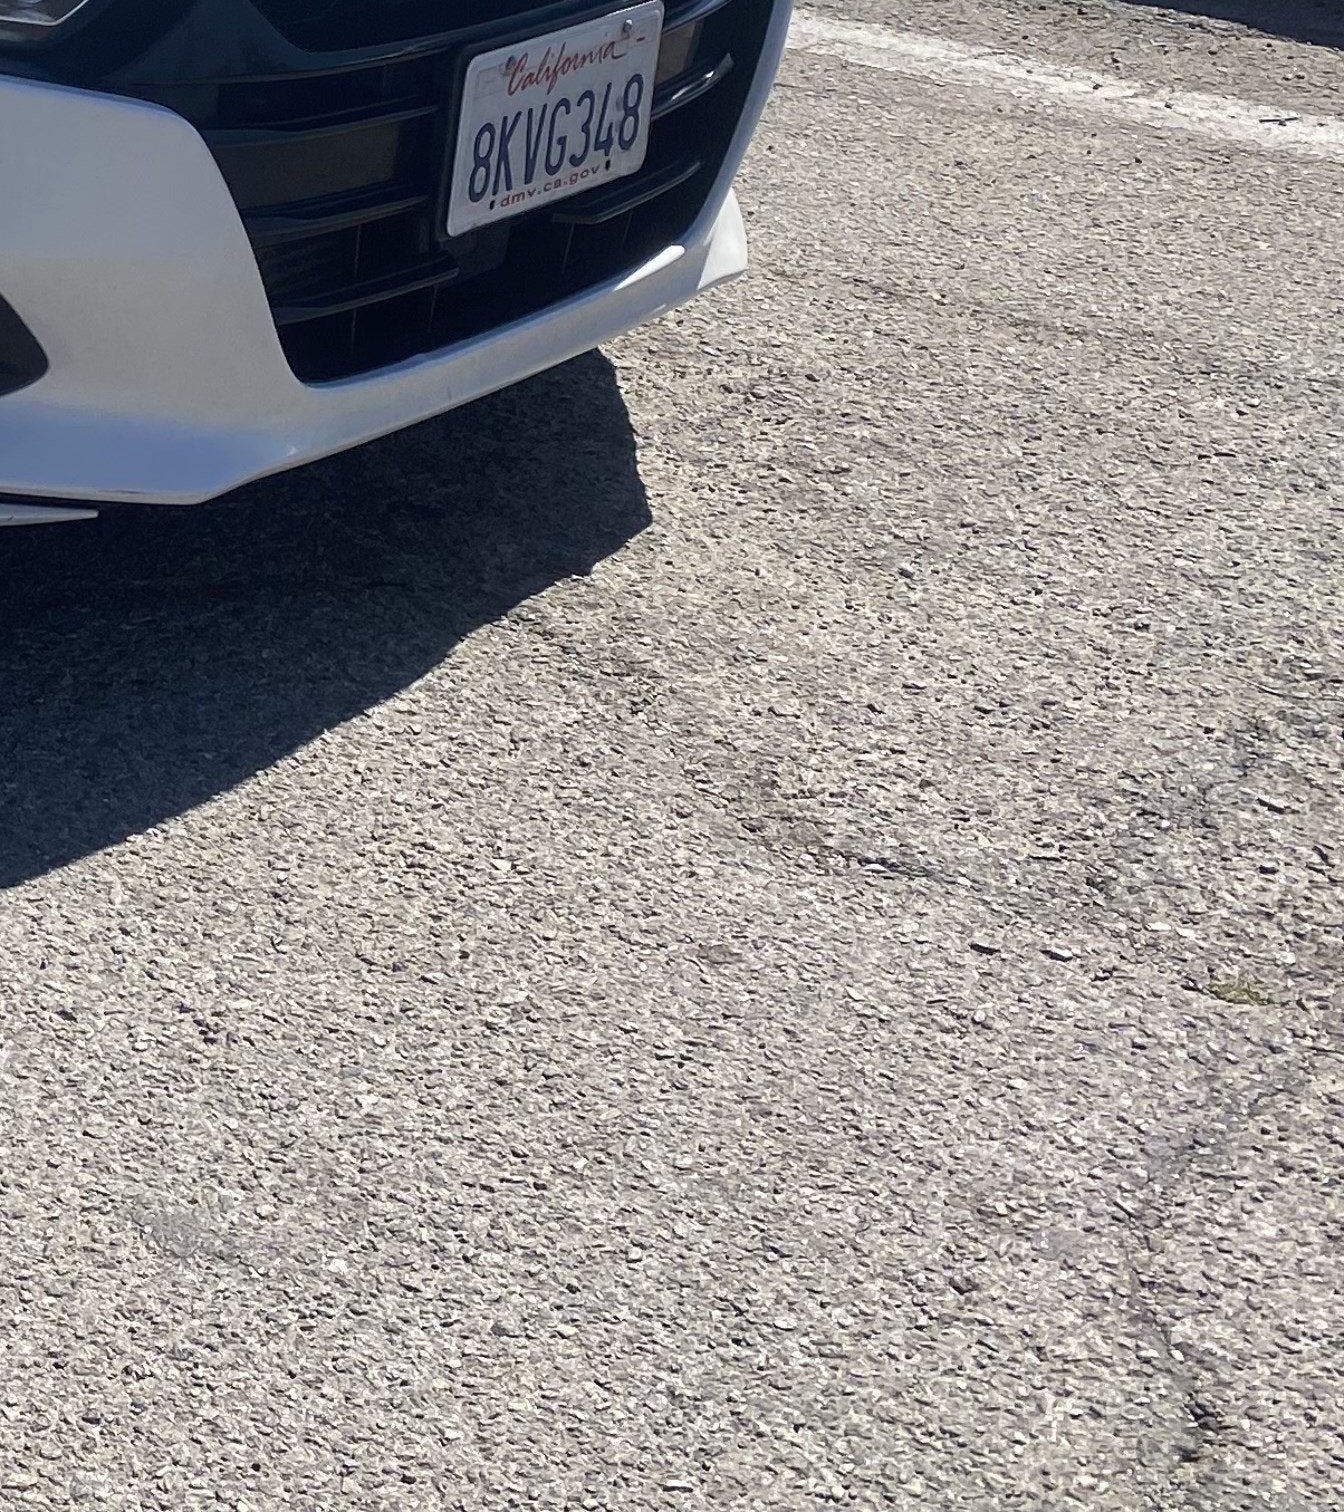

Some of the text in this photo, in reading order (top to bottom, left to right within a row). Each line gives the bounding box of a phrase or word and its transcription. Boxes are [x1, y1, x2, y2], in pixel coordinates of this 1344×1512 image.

[505, 33, 628, 97] California
[467, 72, 645, 204] 8KVG348
[499, 164, 601, 208] dmv.ca.gov
